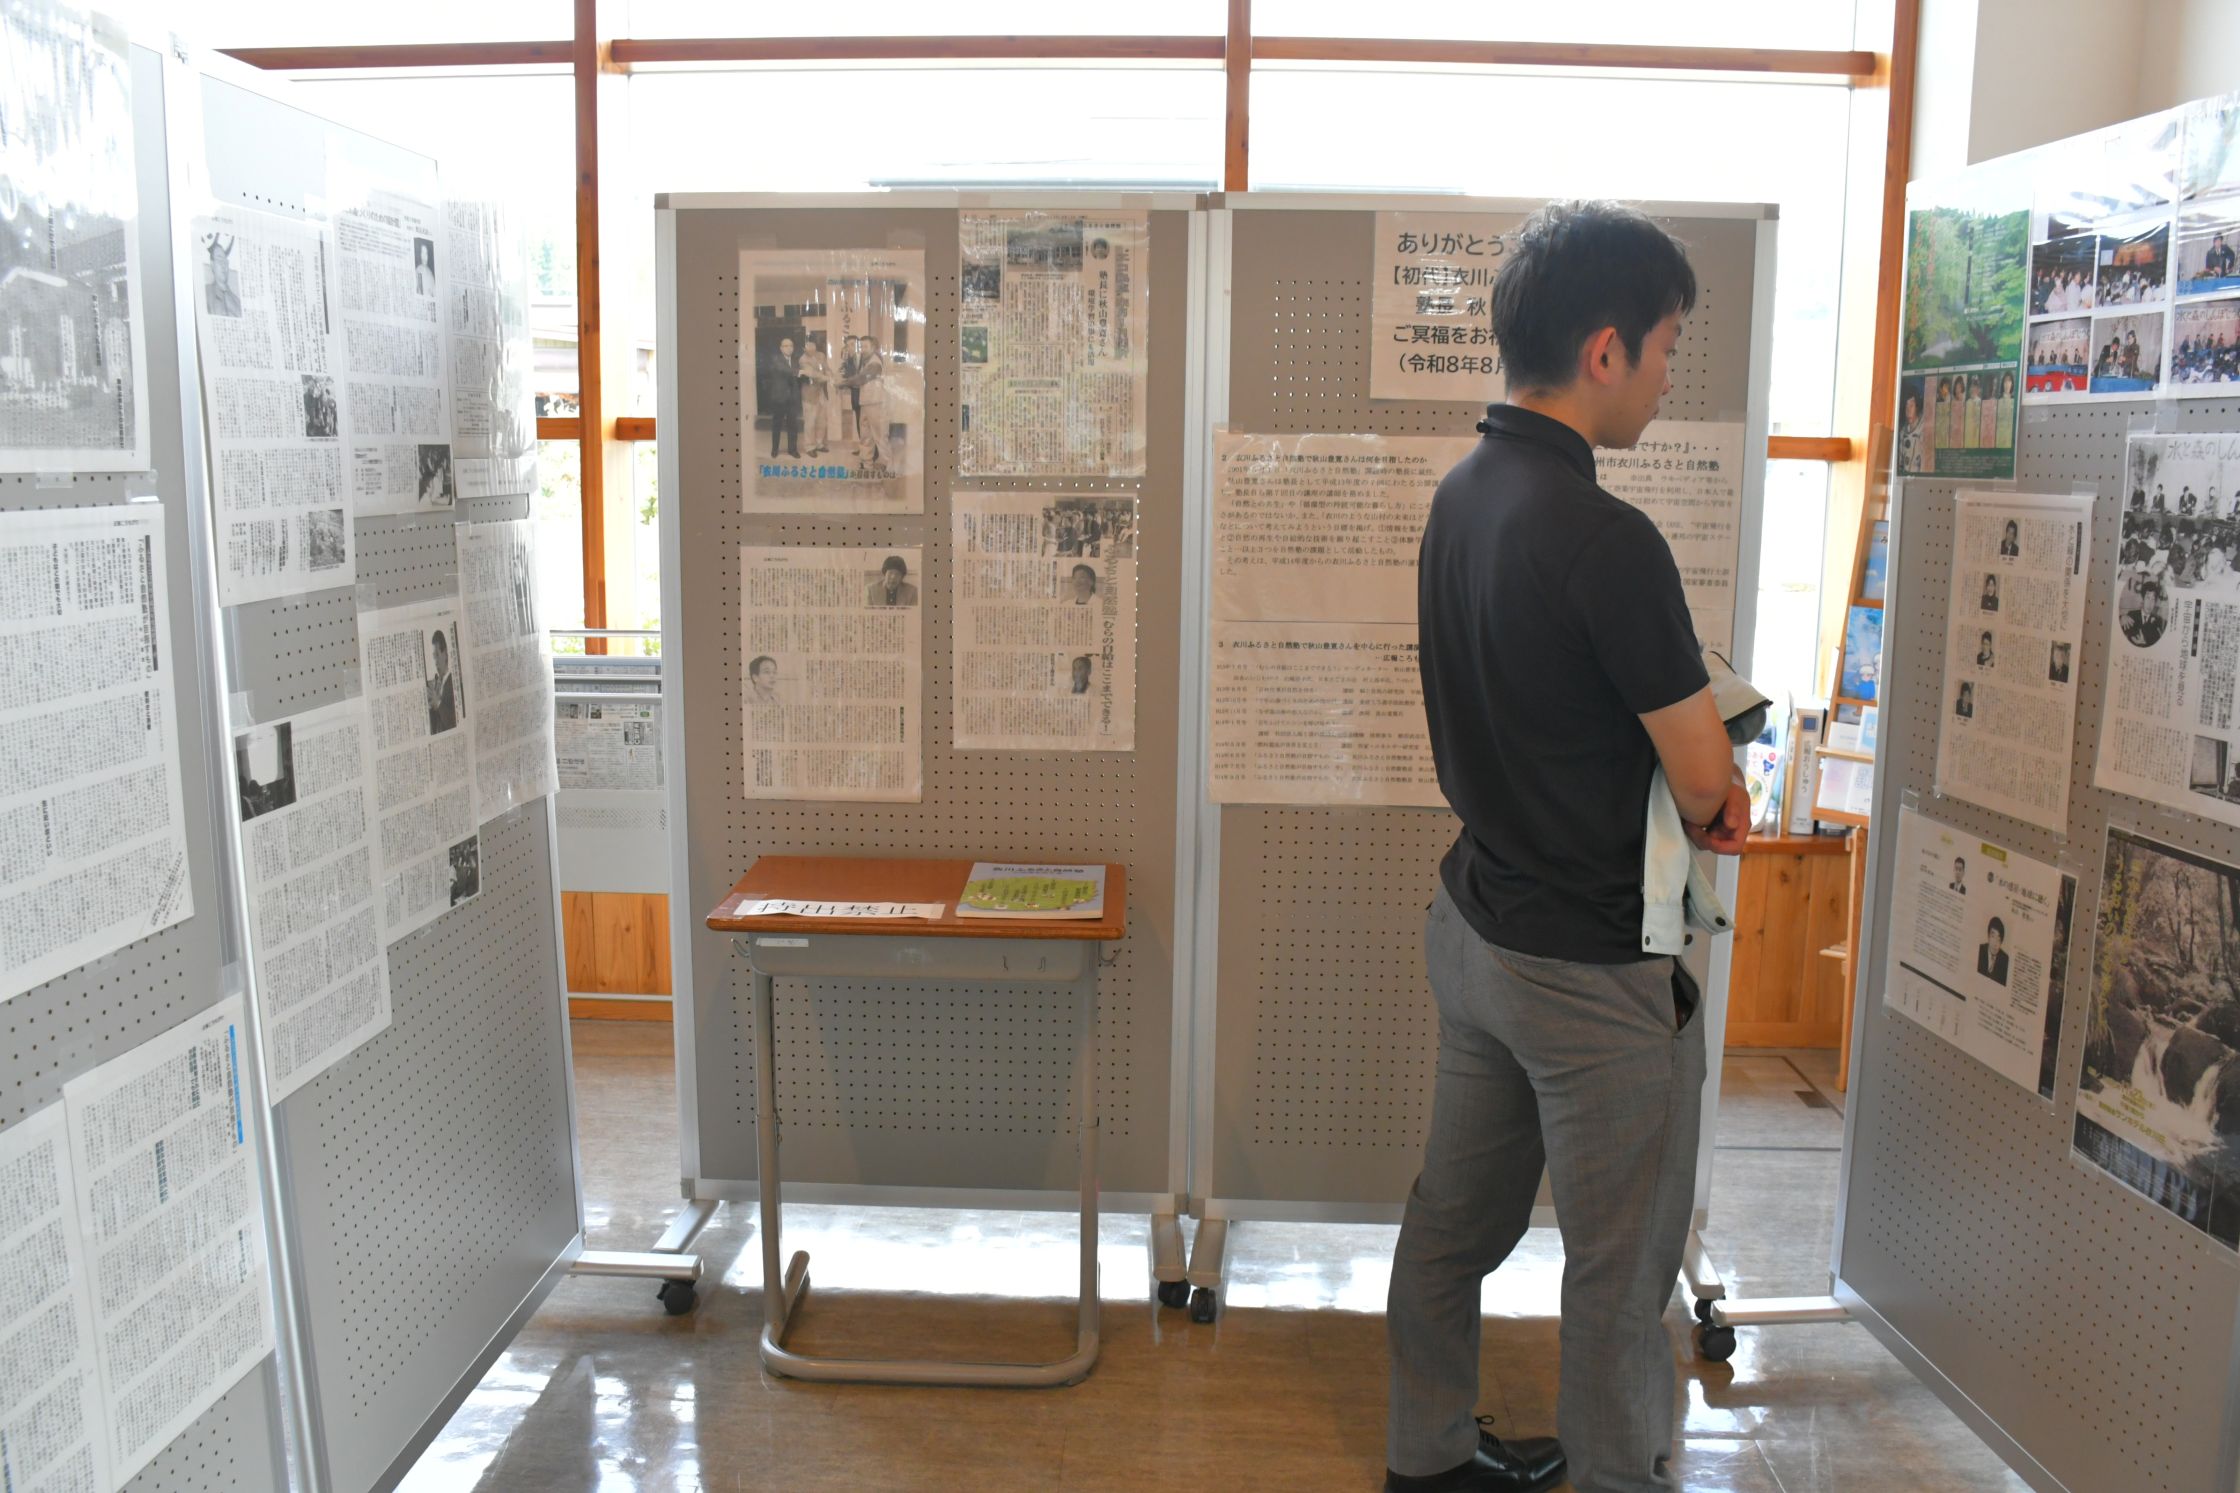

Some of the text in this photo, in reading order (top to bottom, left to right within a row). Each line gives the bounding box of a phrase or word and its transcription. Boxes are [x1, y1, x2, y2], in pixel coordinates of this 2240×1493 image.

[1397, 231, 1505, 257] ありがとう
